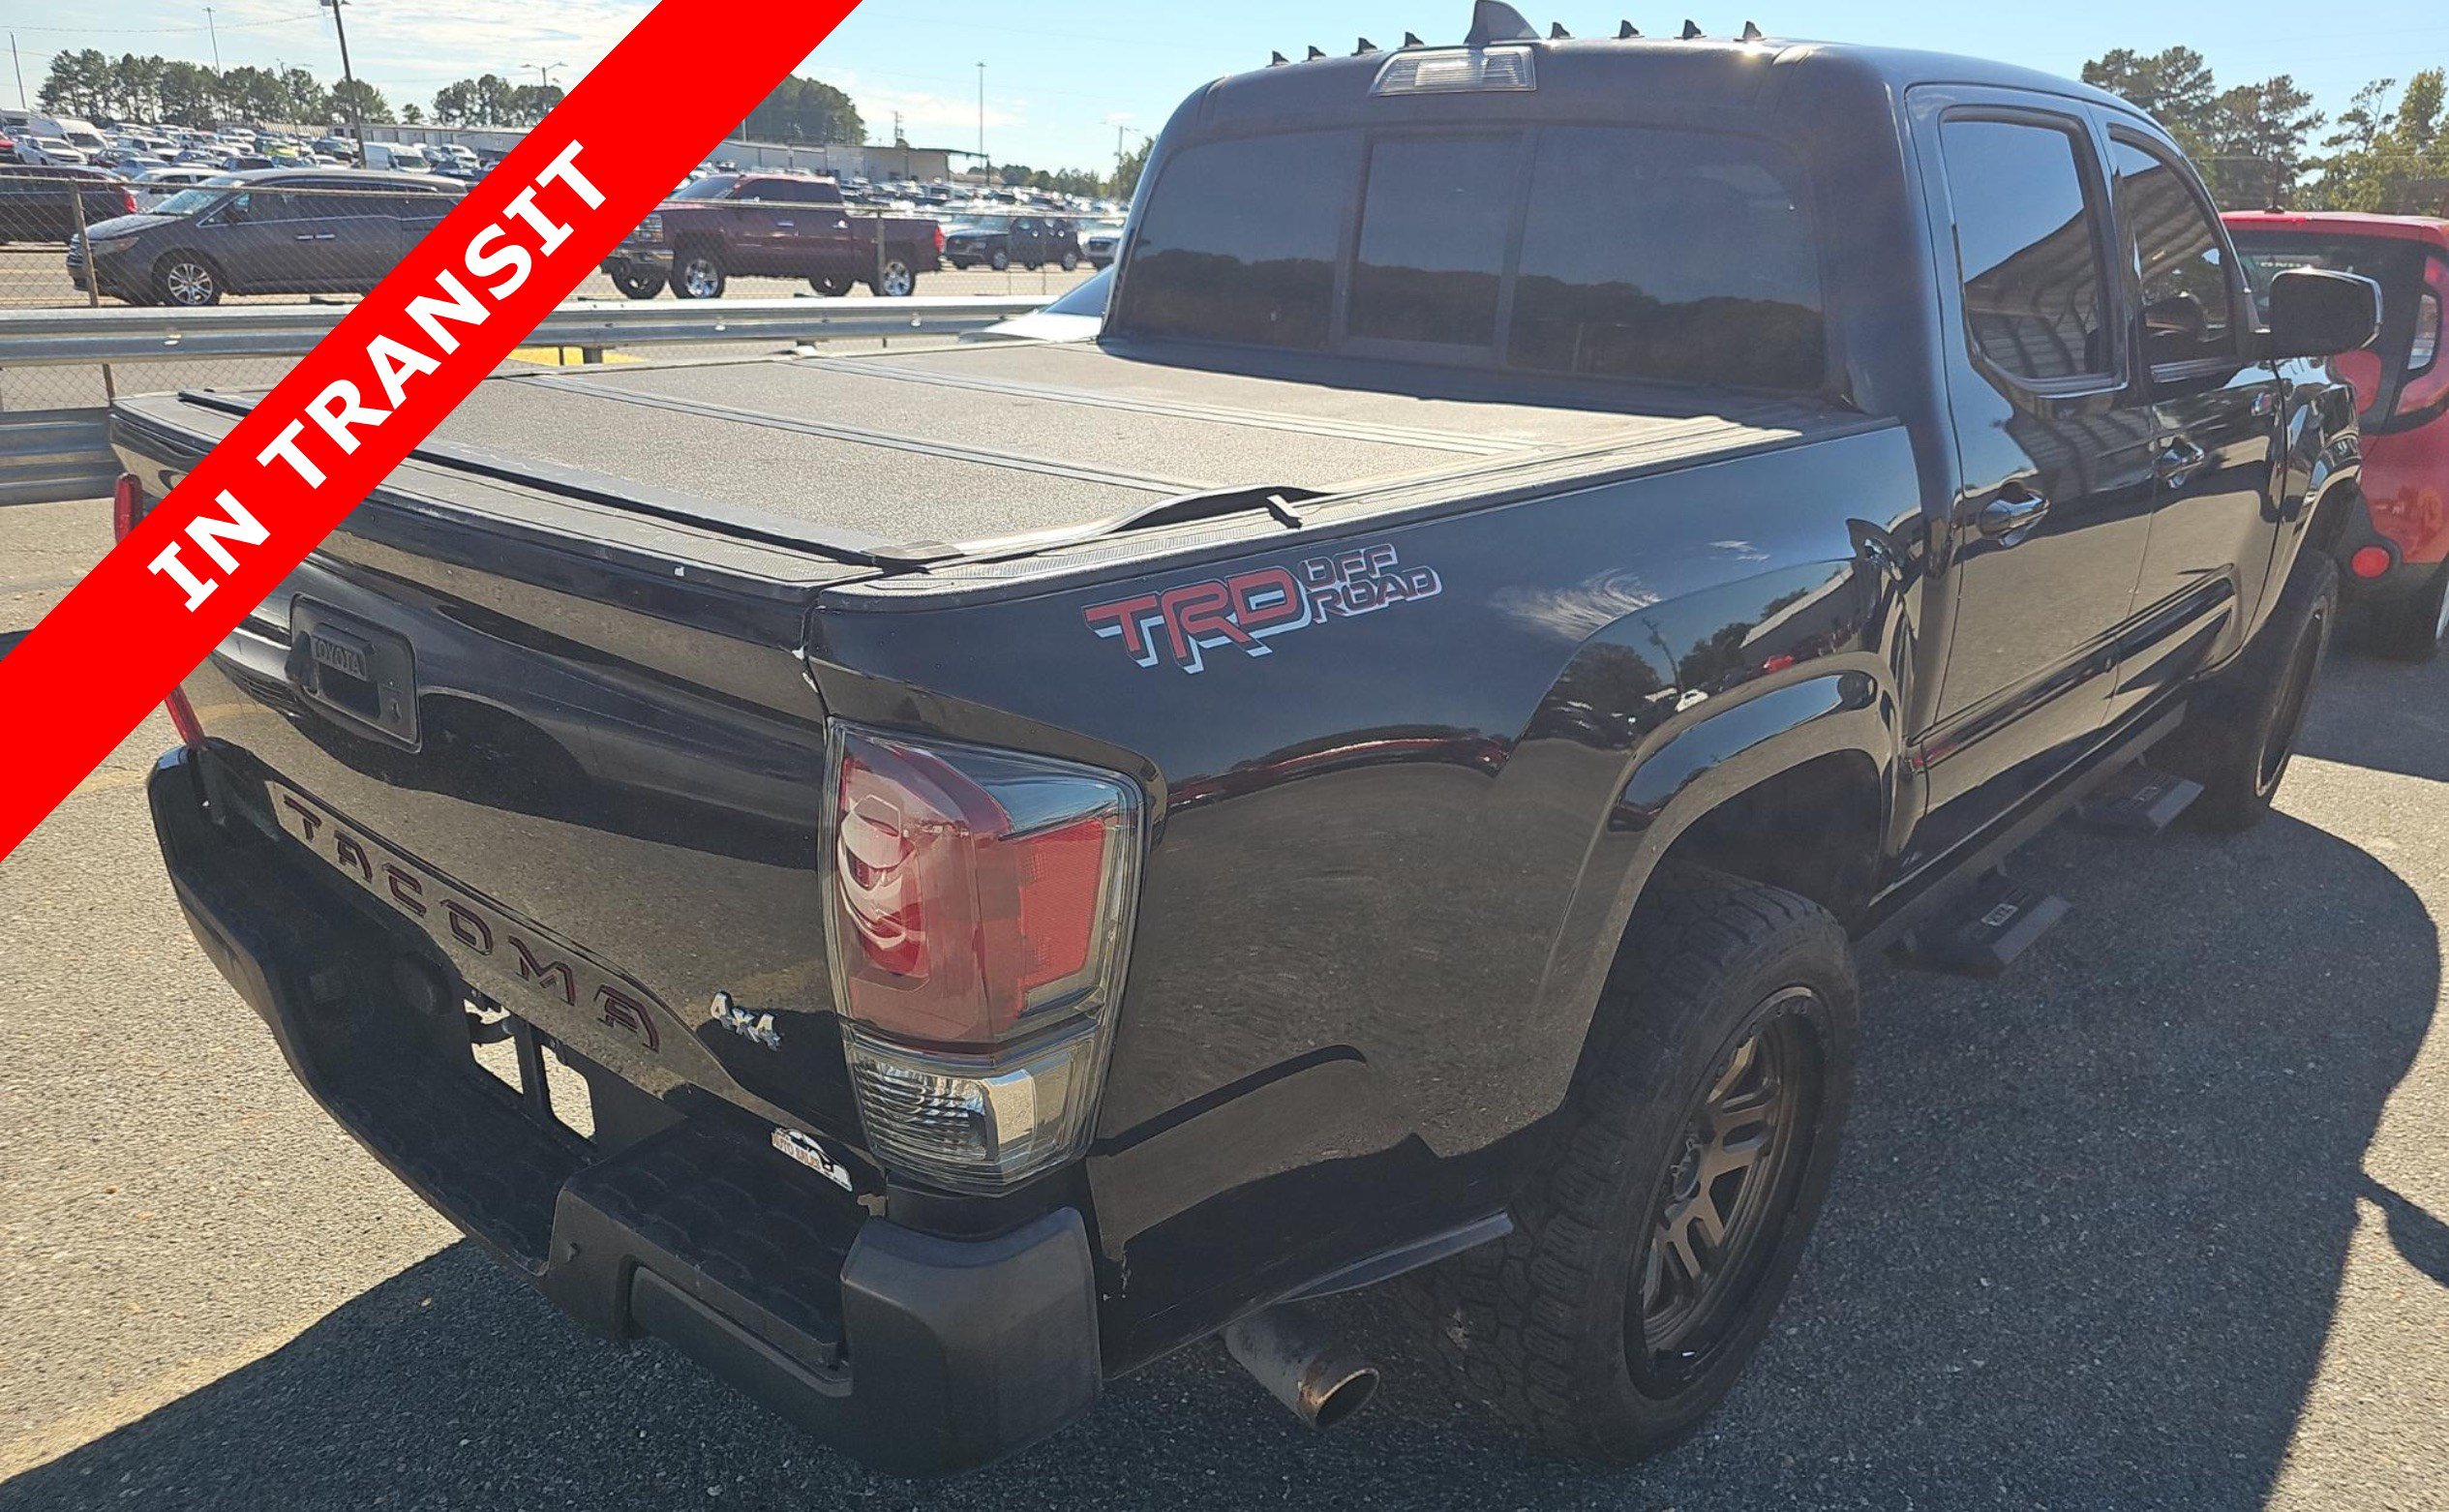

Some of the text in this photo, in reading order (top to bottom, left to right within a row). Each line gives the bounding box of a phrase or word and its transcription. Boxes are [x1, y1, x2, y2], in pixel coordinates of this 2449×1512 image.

[1298, 543, 1399, 592] OFF
[1306, 565, 1442, 624] ROAD
[1080, 566, 1313, 675] TRD
[312, 636, 362, 675] TOYOTA
[284, 793, 661, 1053] TACOMA
